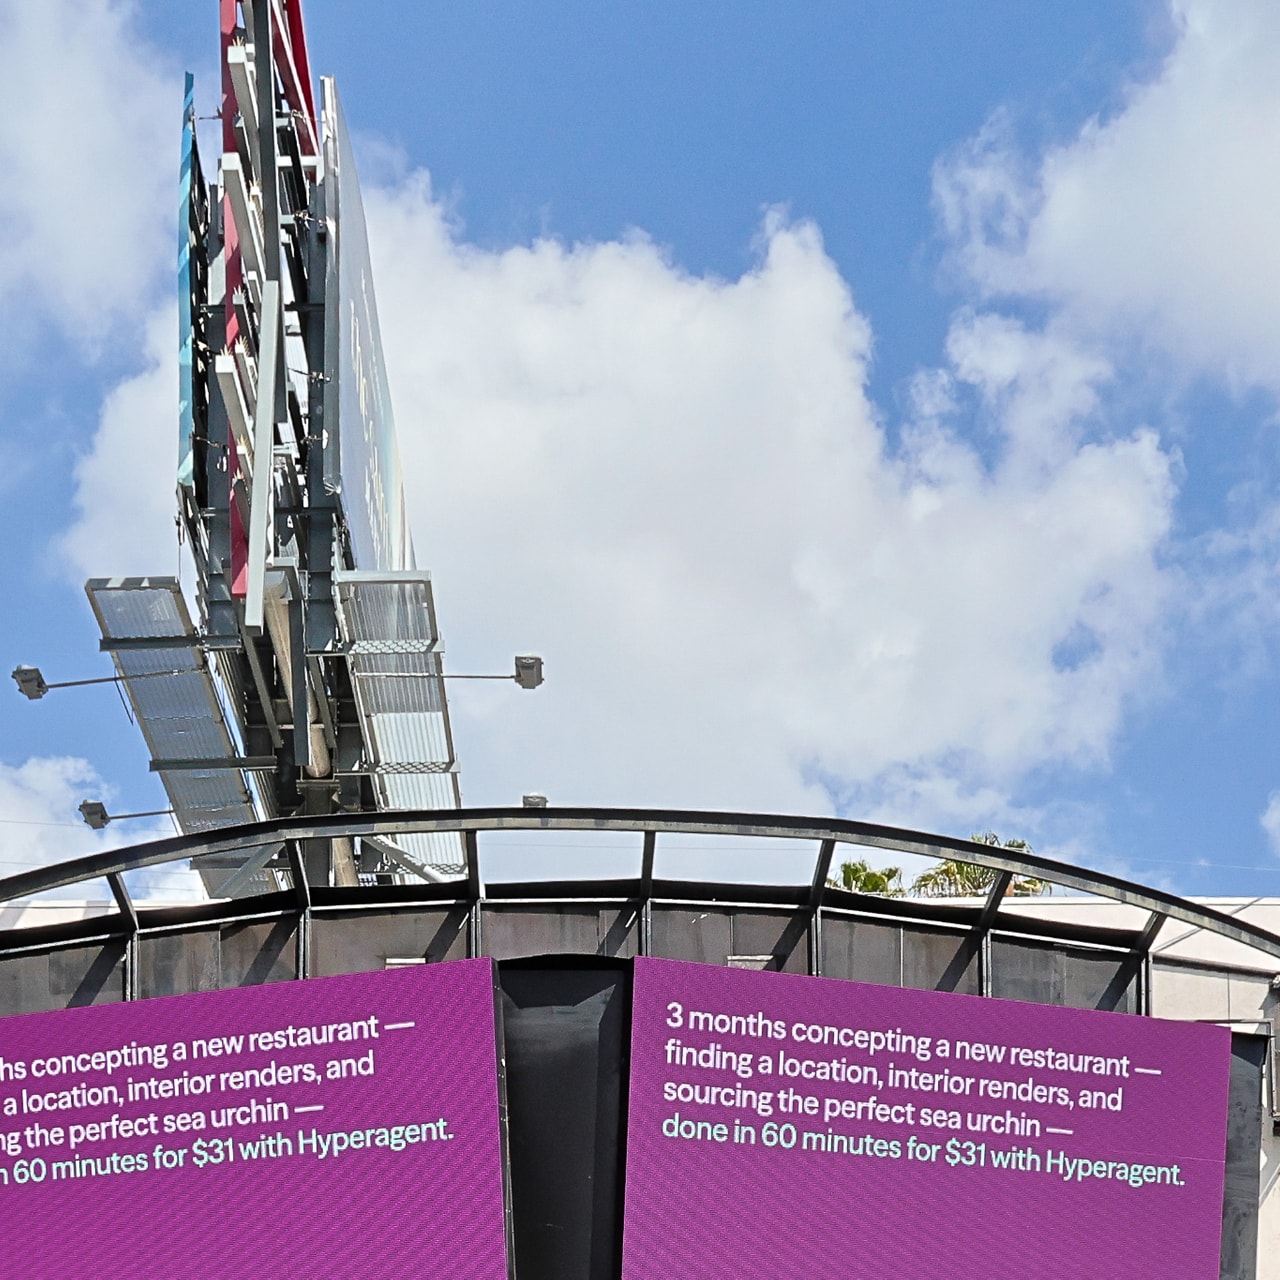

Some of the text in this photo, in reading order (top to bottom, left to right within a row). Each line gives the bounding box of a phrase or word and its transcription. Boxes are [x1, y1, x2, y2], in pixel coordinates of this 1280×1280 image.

[31, 1041, 169, 1078] concepting
[172, 1042, 187, 1061] a
[192, 1035, 245, 1059] new
[249, 1015, 380, 1052] restaurant
[666, 1001, 684, 1028] 3
[688, 1011, 787, 1040] months
[791, 1022, 932, 1062] concepting
[935, 1039, 950, 1058] a
[955, 1041, 1007, 1063] new
[1010, 1047, 1130, 1078] restaurant
[3, 1097, 18, 1116] a
[22, 1082, 124, 1114] location,
[127, 1070, 216, 1102] interior
[219, 1060, 322, 1091] renders,
[326, 1049, 375, 1080] and
[664, 1038, 1123, 1111] finding a location, interior renders, and
[23, 1122, 65, 1149] the
[69, 1113, 159, 1150] perfect
[163, 1111, 206, 1133] sea
[210, 1097, 289, 1128] urchin
[663, 1082, 774, 1117] sourcing
[776, 1087, 819, 1115] the
[824, 1095, 916, 1125] perfect
[919, 1108, 962, 1130] sea
[966, 1110, 1041, 1137] urchin
[13, 1157, 47, 1184] 60
[51, 1152, 149, 1180] minutes
[152, 1144, 188, 1169] for
[192, 1137, 234, 1169] $31
[238, 1131, 293, 1161] with
[298, 1117, 454, 1160] Hyperagent.
[662, 1112, 1186, 1188] done in 60 minutes for $31 with Hyperagent.
